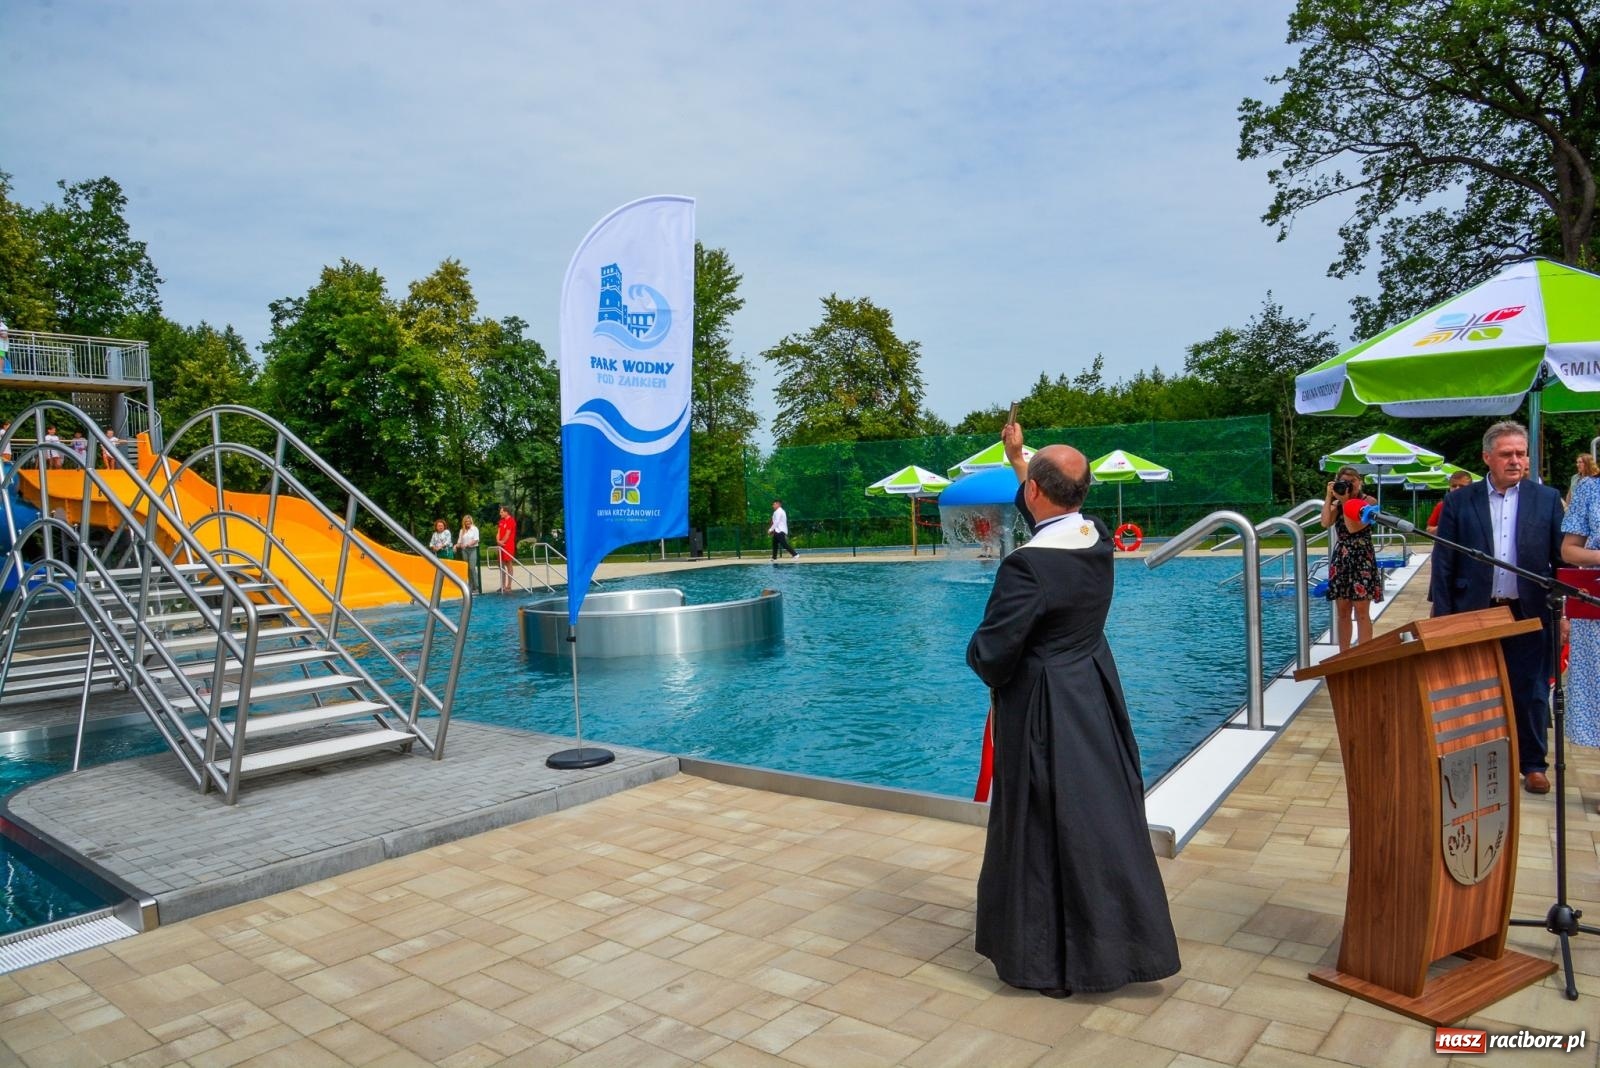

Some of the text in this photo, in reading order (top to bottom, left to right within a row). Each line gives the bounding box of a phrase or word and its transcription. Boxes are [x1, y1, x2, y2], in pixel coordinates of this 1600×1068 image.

[590, 356, 675, 375] PARK WODNY
[596, 373, 667, 389] POD ZAMKIEM
